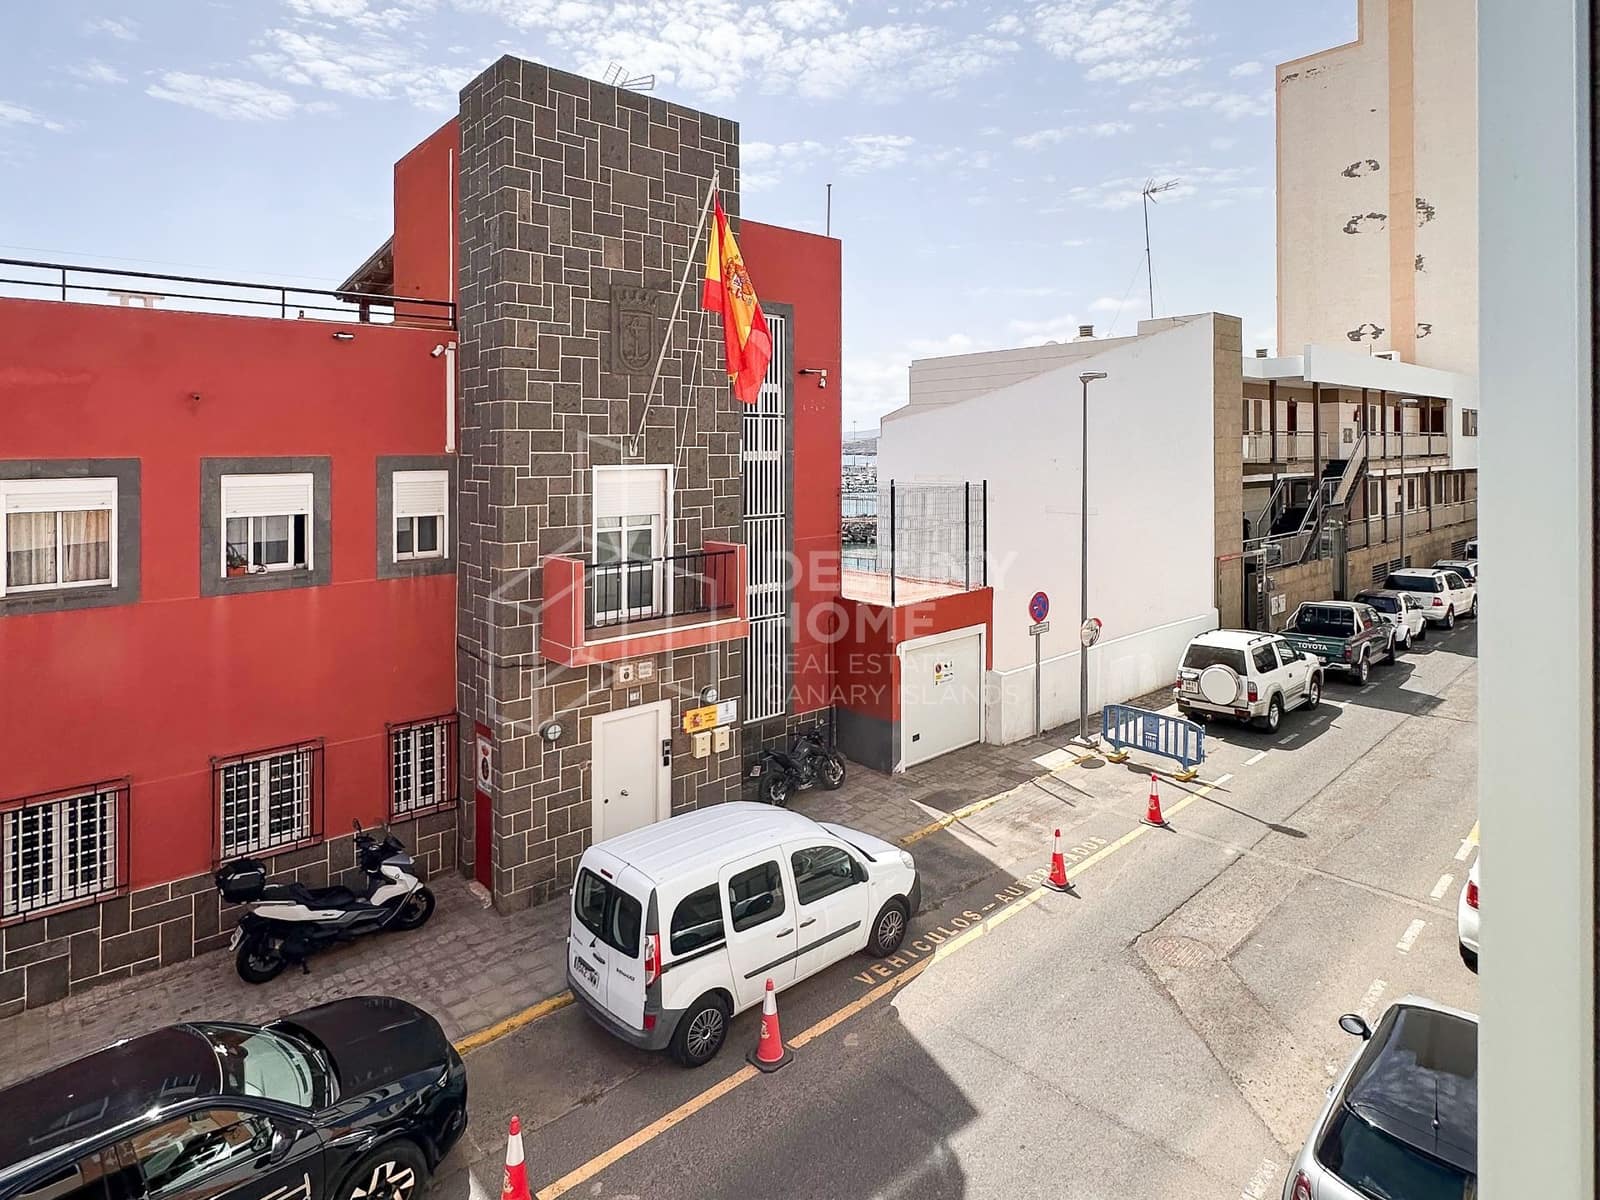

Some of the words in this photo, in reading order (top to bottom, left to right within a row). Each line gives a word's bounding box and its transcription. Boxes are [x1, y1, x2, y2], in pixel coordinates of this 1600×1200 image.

[1297, 642, 1328, 651] TOYOTA
[854, 909, 982, 985] VEHICULOS
[999, 837, 1106, 903] AUTORADOS
